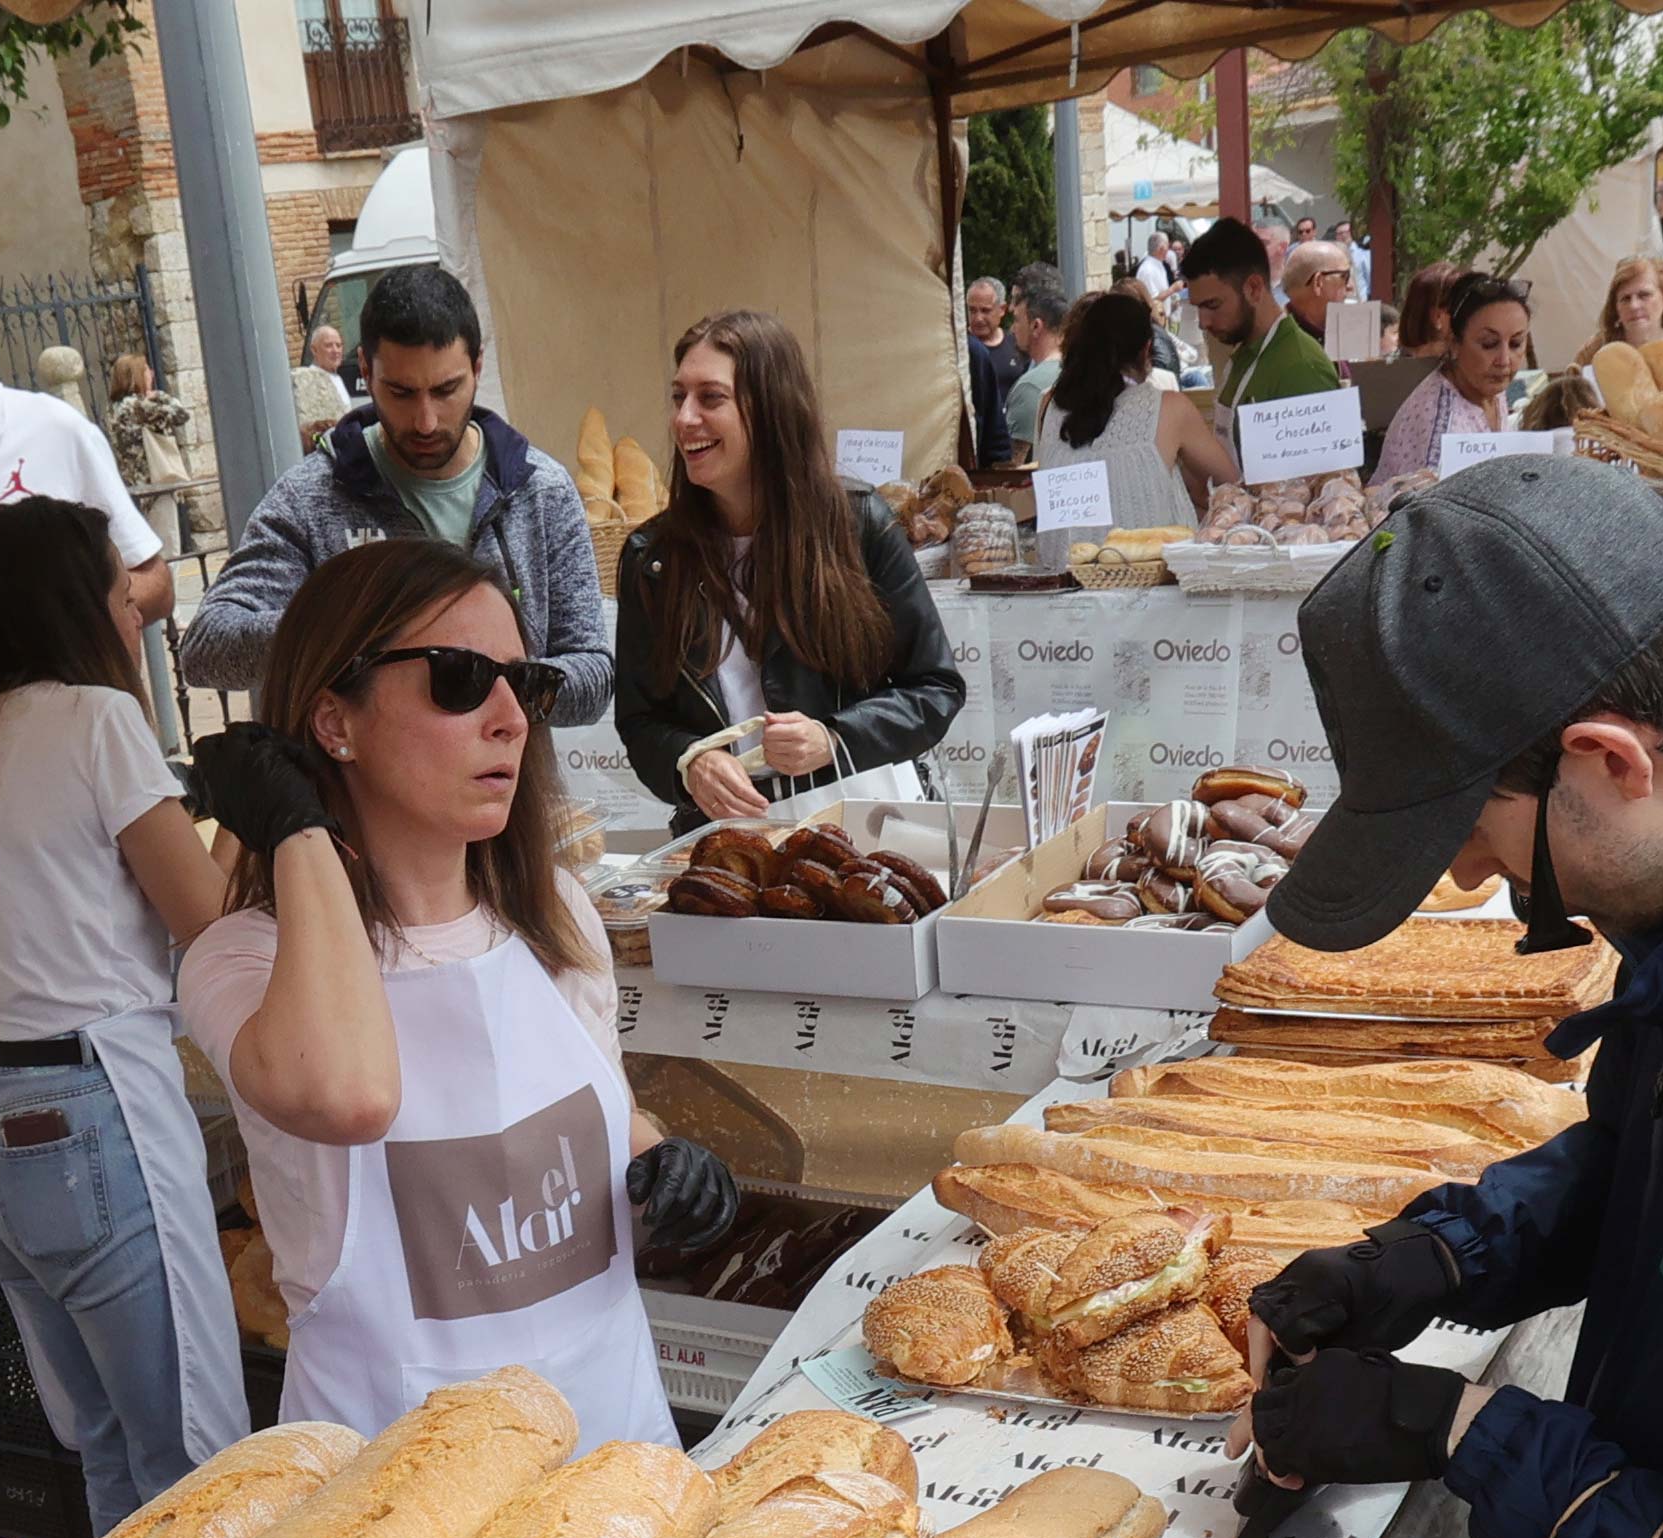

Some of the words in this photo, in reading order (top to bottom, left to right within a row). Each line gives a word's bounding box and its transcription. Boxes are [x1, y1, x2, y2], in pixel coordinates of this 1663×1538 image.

[1457, 440, 1498, 455] TORTA
[1018, 639, 1094, 663] Oviedo
[1153, 639, 1232, 663] Oviedo
[1149, 743, 1224, 767] Oviedo
[454, 1189, 582, 1271] Alar
[659, 1344, 675, 1362] EL
[676, 1346, 707, 1367] ALAR
[847, 1386, 914, 1419] PAN
